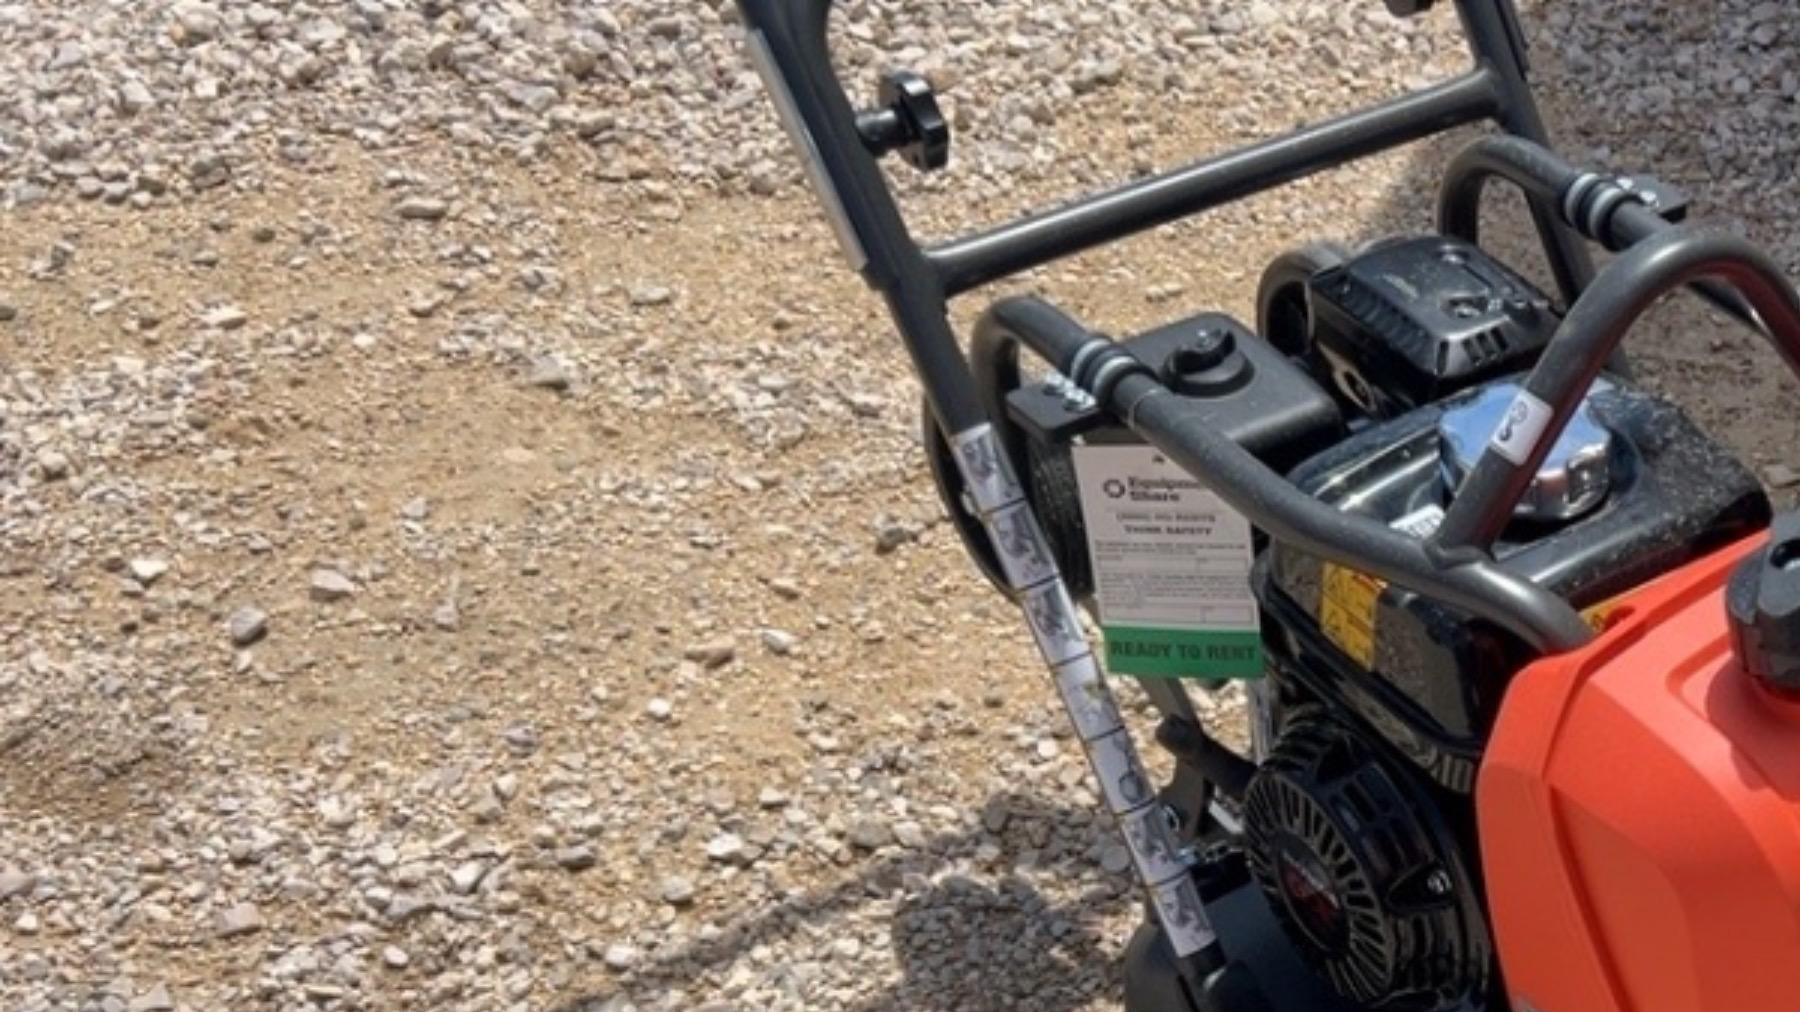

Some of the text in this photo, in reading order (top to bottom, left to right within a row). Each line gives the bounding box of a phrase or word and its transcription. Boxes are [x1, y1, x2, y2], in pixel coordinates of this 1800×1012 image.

[1110, 640, 1256, 662] READY TO RENT
